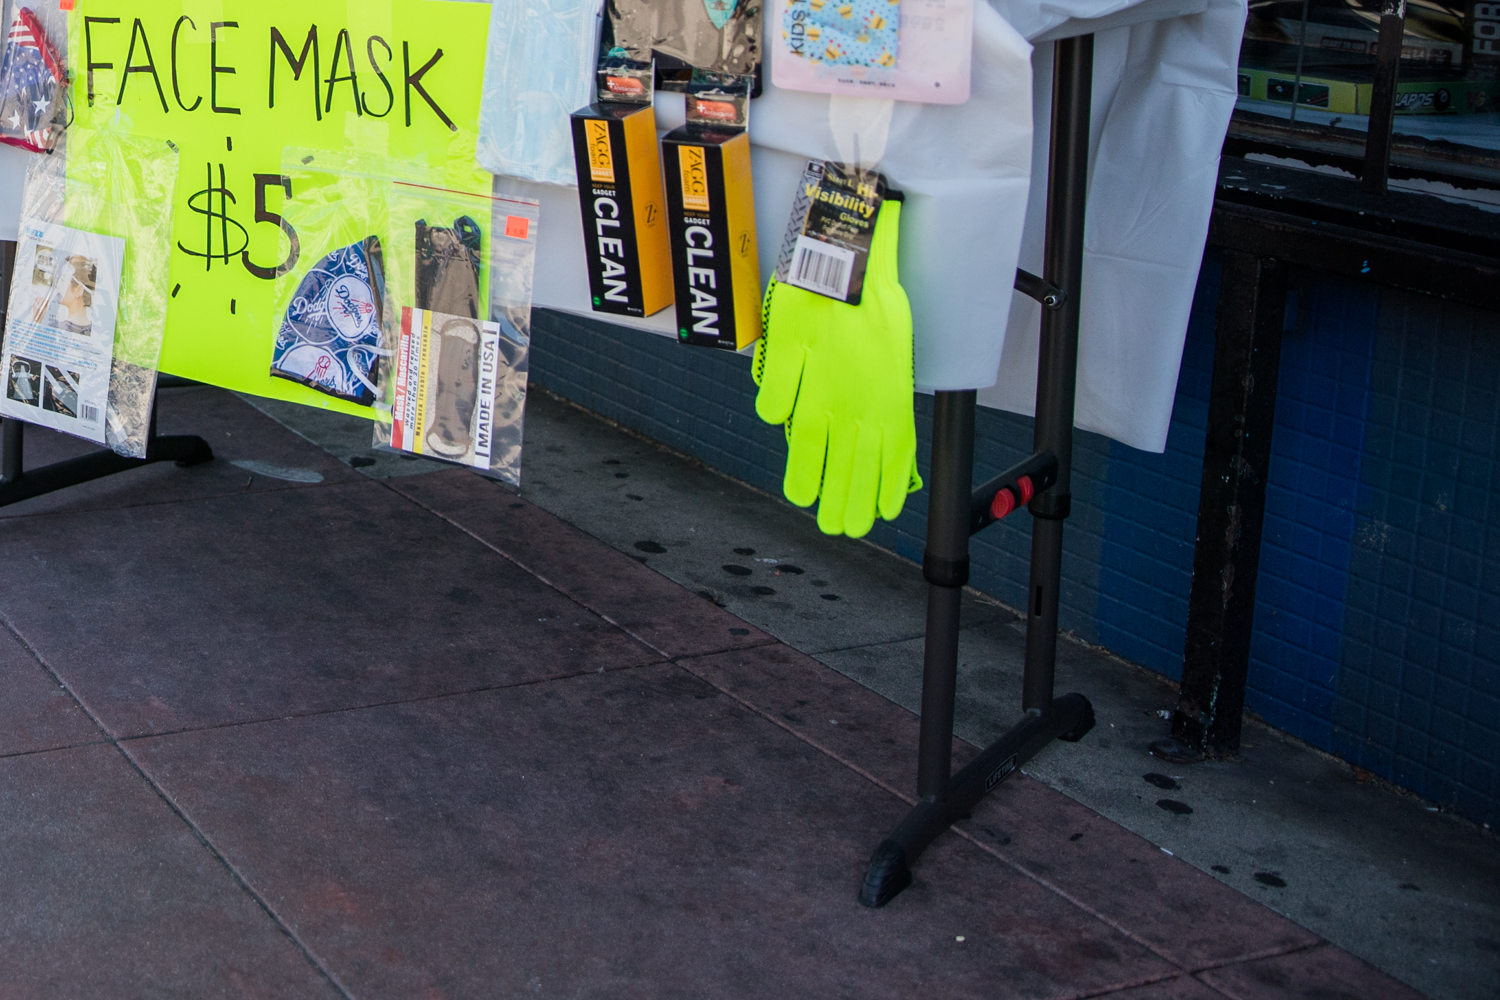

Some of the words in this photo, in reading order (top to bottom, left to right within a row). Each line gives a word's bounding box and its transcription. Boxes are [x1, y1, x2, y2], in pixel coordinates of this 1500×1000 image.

[790, 9, 806, 56] KIDS
[84, 14, 243, 116] FACE
[269, 23, 458, 132] MASK
[593, 122, 611, 168] ZAGG
[688, 148, 706, 197] ZAGG
[592, 188, 617, 197] GADGET
[805, 183, 876, 219] Visibility
[857, 182, 879, 199] Hi-
[177, 162, 301, 281] $5
[684, 217, 711, 226] GADGET
[839, 212, 870, 229] Gloves
[593, 197, 630, 304] CLEAN
[685, 225, 720, 336] CLEAN
[292, 296, 326, 319] Dodg
[335, 284, 364, 328] Dodgers
[396, 334, 410, 387] Mascarilla
[413, 335, 421, 362] times
[419, 325, 429, 361] reusable
[482, 340, 496, 373] USA
[406, 369, 414, 386] and
[412, 365, 419, 377] 20
[417, 370, 426, 401] lavable
[480, 377, 492, 394] IN
[395, 394, 406, 421] Mask
[404, 389, 412, 427] Washed
[410, 380, 418, 403] than
[415, 402, 424, 437] Mascara
[478, 400, 492, 448] MADE
